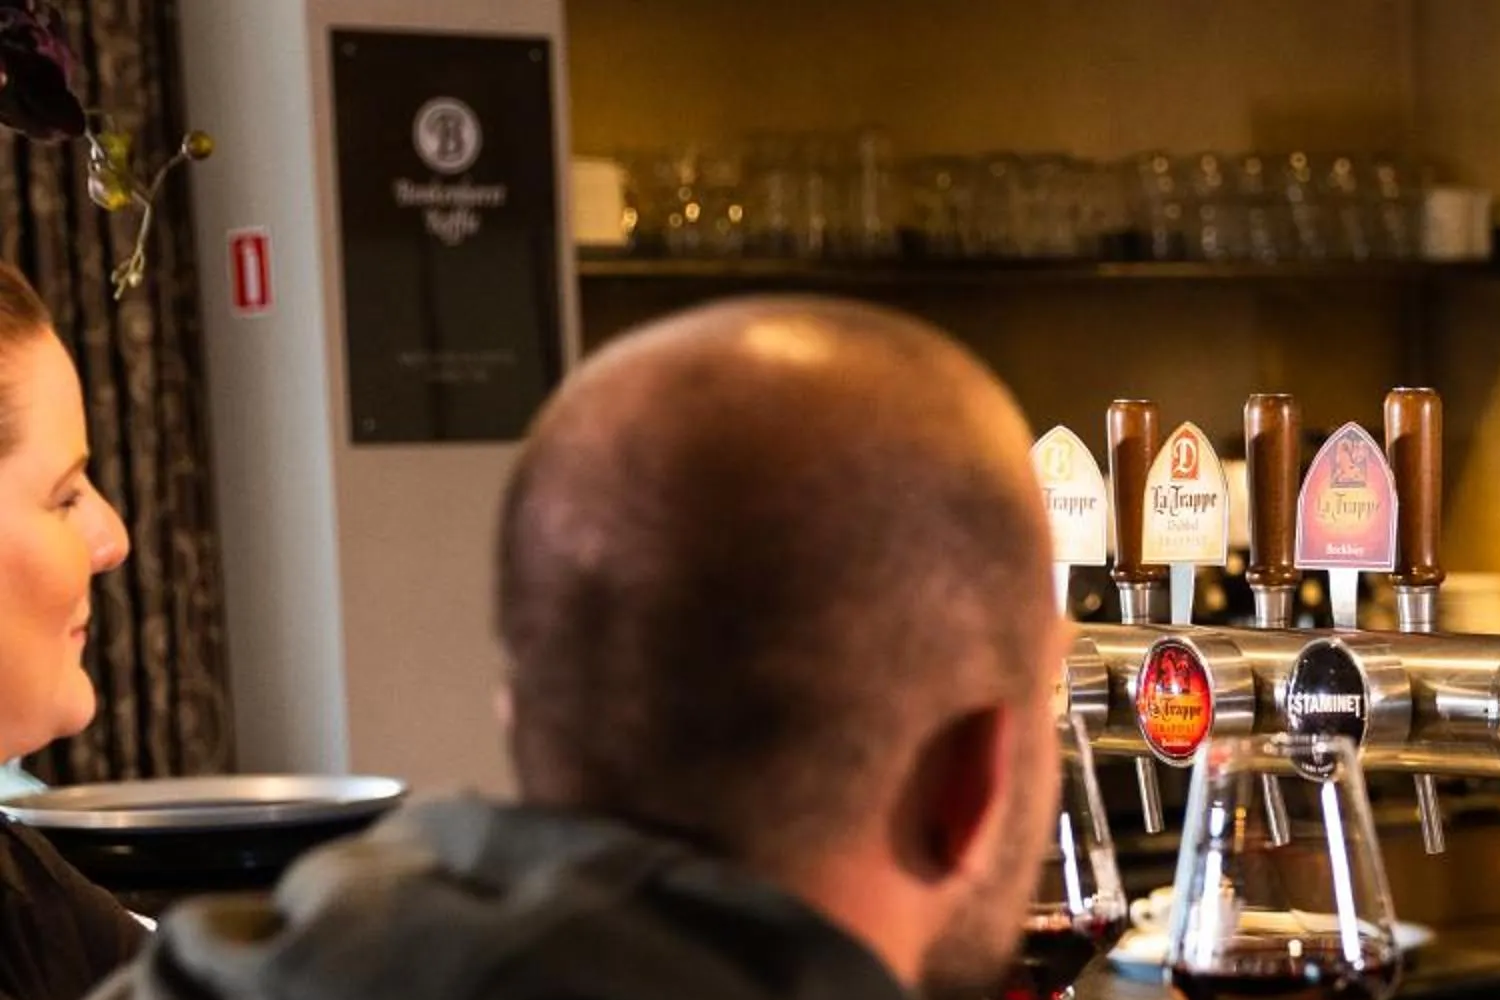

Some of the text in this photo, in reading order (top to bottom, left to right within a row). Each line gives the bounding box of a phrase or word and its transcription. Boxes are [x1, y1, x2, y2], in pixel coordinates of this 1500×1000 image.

[1172, 437, 1198, 475] D
[1043, 487, 1097, 517] Trappe
[1151, 485, 1218, 517] La Trappe
[1331, 492, 1380, 521] Trappe
[1161, 695, 1204, 721] Trappe
